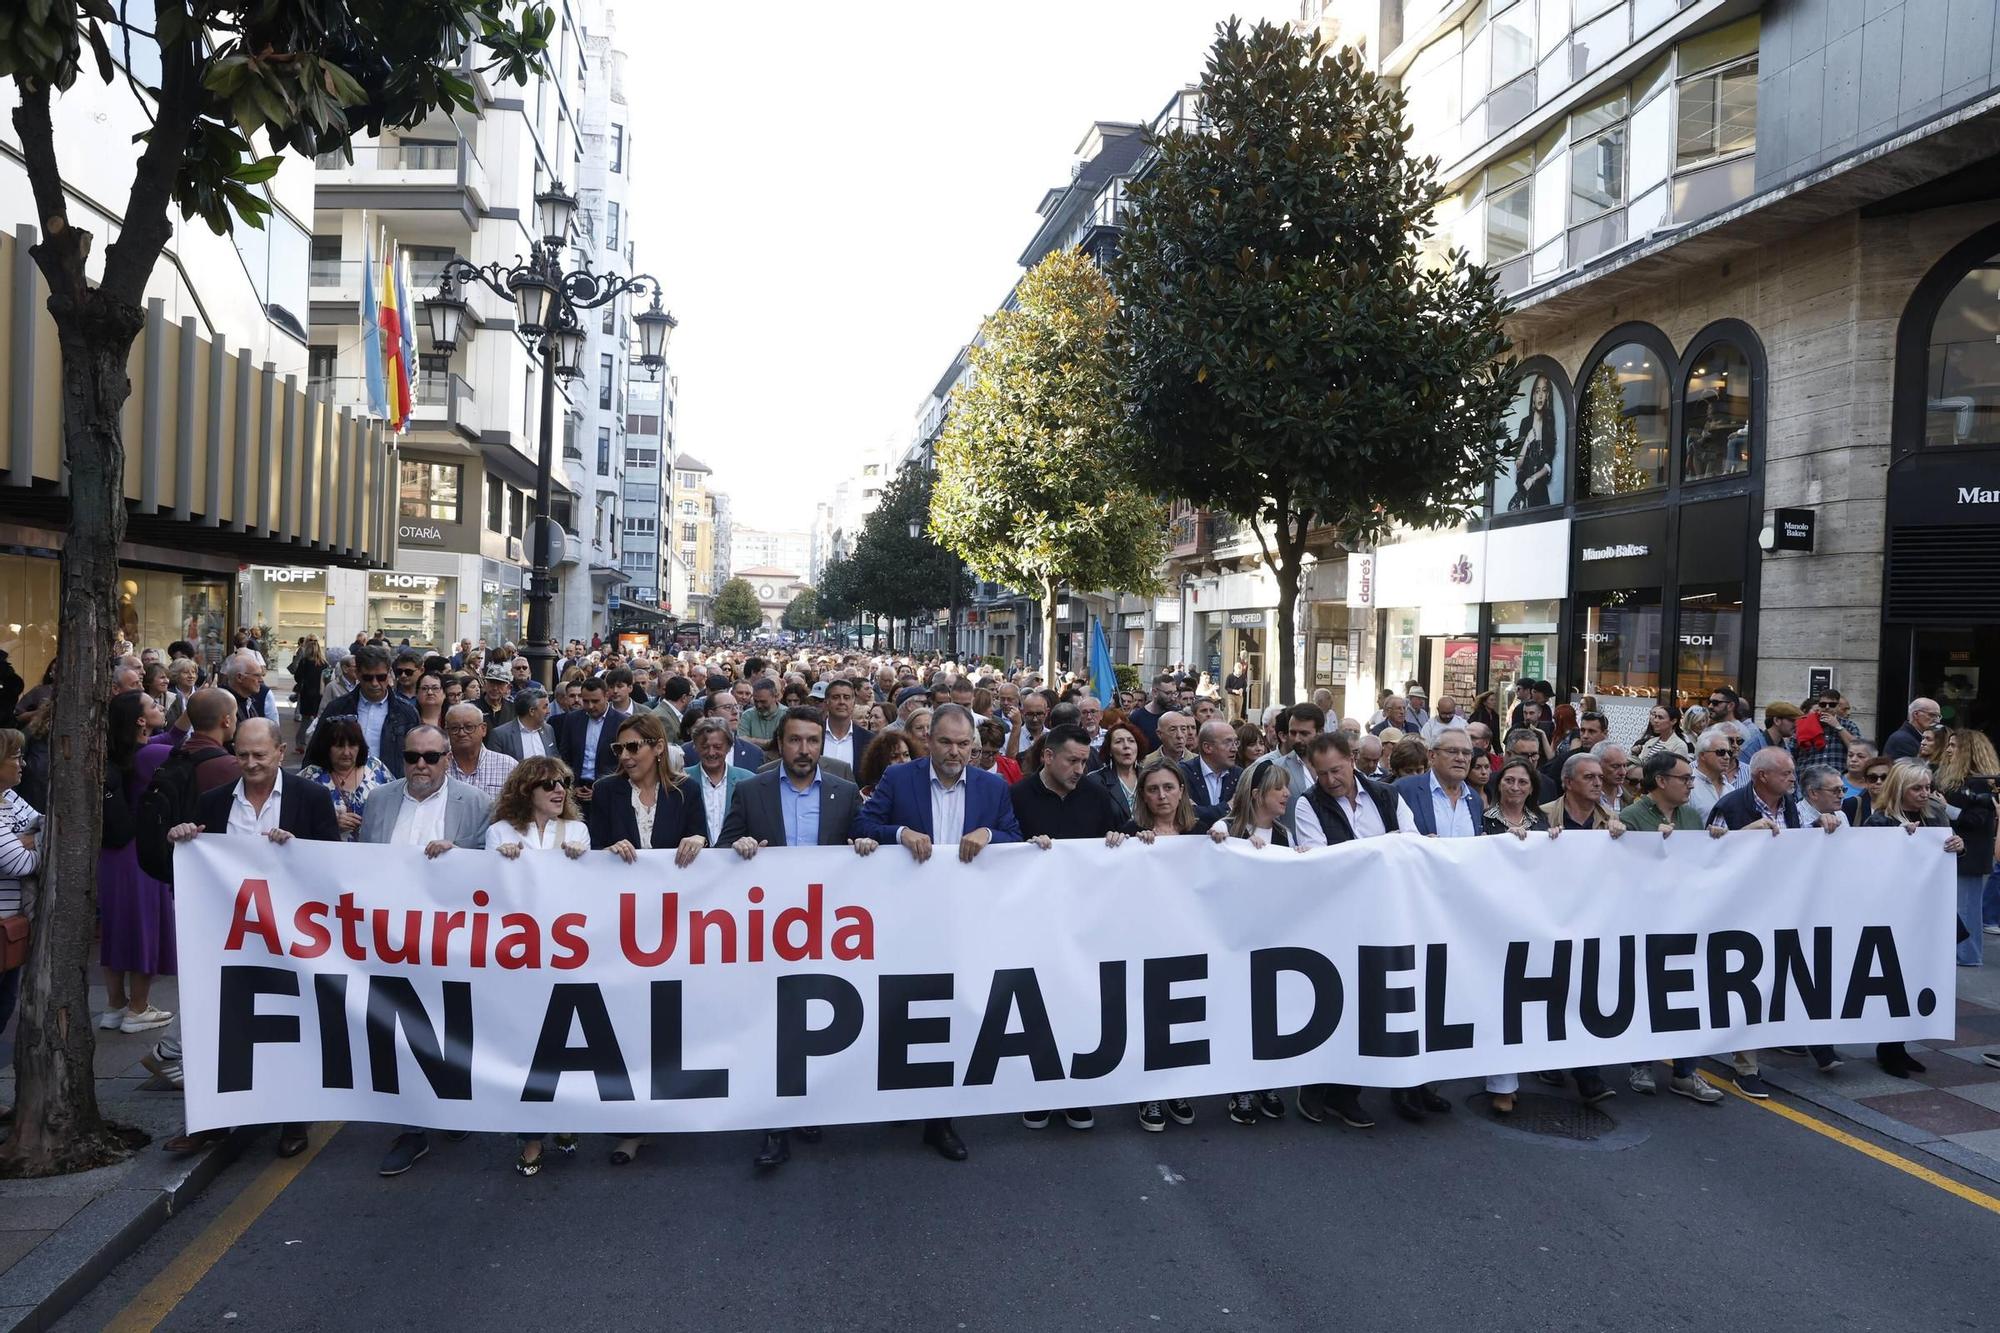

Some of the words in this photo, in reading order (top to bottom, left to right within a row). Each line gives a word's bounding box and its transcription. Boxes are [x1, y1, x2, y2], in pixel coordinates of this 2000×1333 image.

[399, 525, 442, 540] OTARÍA
[1784, 522, 1809, 532] Manolo
[1786, 530, 1807, 538] Bakes
[1583, 546, 1615, 561] Manolo
[1616, 544, 1647, 558] Bakes
[264, 569, 316, 582] HOFF
[385, 575, 440, 588] HOFF
[1359, 559, 1371, 602] claire's
[1231, 613, 1262, 624] SPRINGFIELD
[225, 879, 590, 970] Asturias
[619, 884, 875, 968] Unida
[217, 965, 475, 1101] FIN
[519, 979, 730, 1103] AL
[776, 953, 1211, 1098] PEAJE
[1250, 943, 1475, 1061] DEL
[1502, 924, 1937, 1046] HUERNA.
